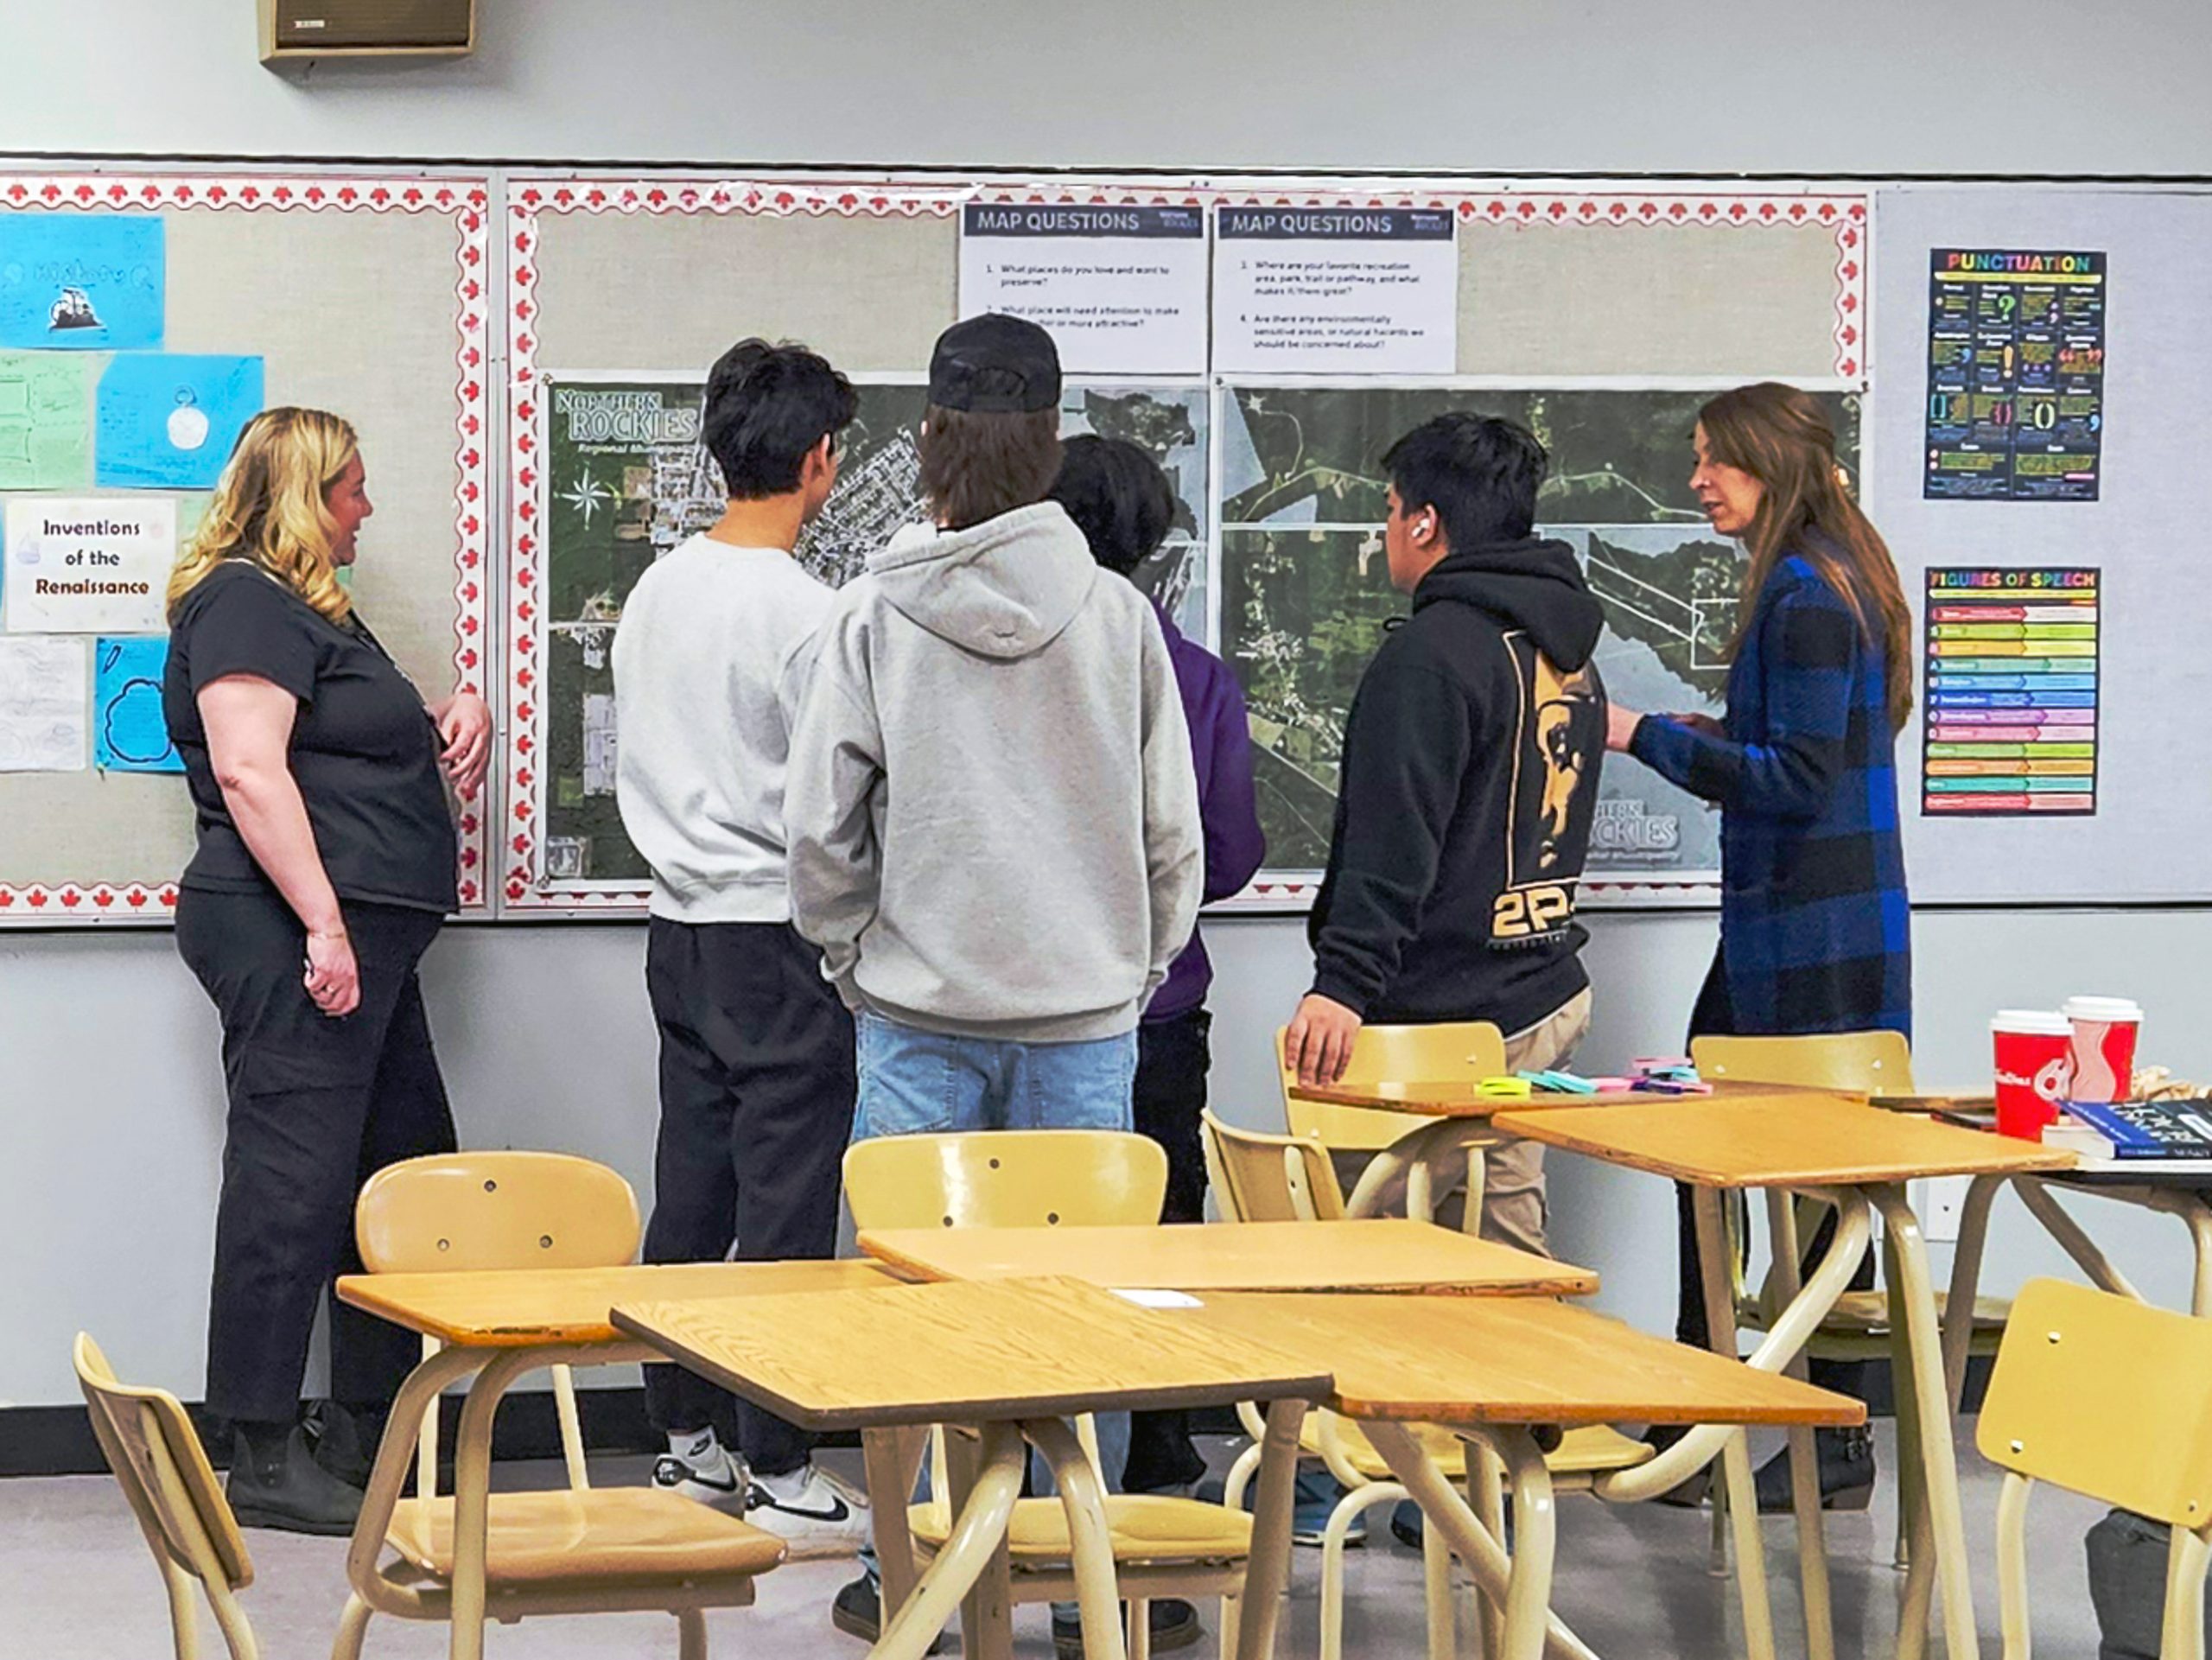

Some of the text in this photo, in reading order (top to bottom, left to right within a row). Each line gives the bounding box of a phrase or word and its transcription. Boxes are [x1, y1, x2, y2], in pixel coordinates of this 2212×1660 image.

[977, 212, 1021, 229] MAP
[1027, 213, 1139, 231] QUESTIONS
[1232, 214, 1275, 232] MAP
[1281, 215, 1392, 234] QUESTIONS
[1948, 253, 2091, 272] PUNCTUATION
[556, 390, 661, 412] NORTHERN
[570, 410, 696, 442] ROCKIES
[43, 519, 140, 536] Inventions
[65, 550, 120, 566] of the
[35, 578, 149, 595] Renaissance
[1930, 572, 2095, 587] FIGURES OF SPEECH
[1592, 817, 1678, 849] CKIES
